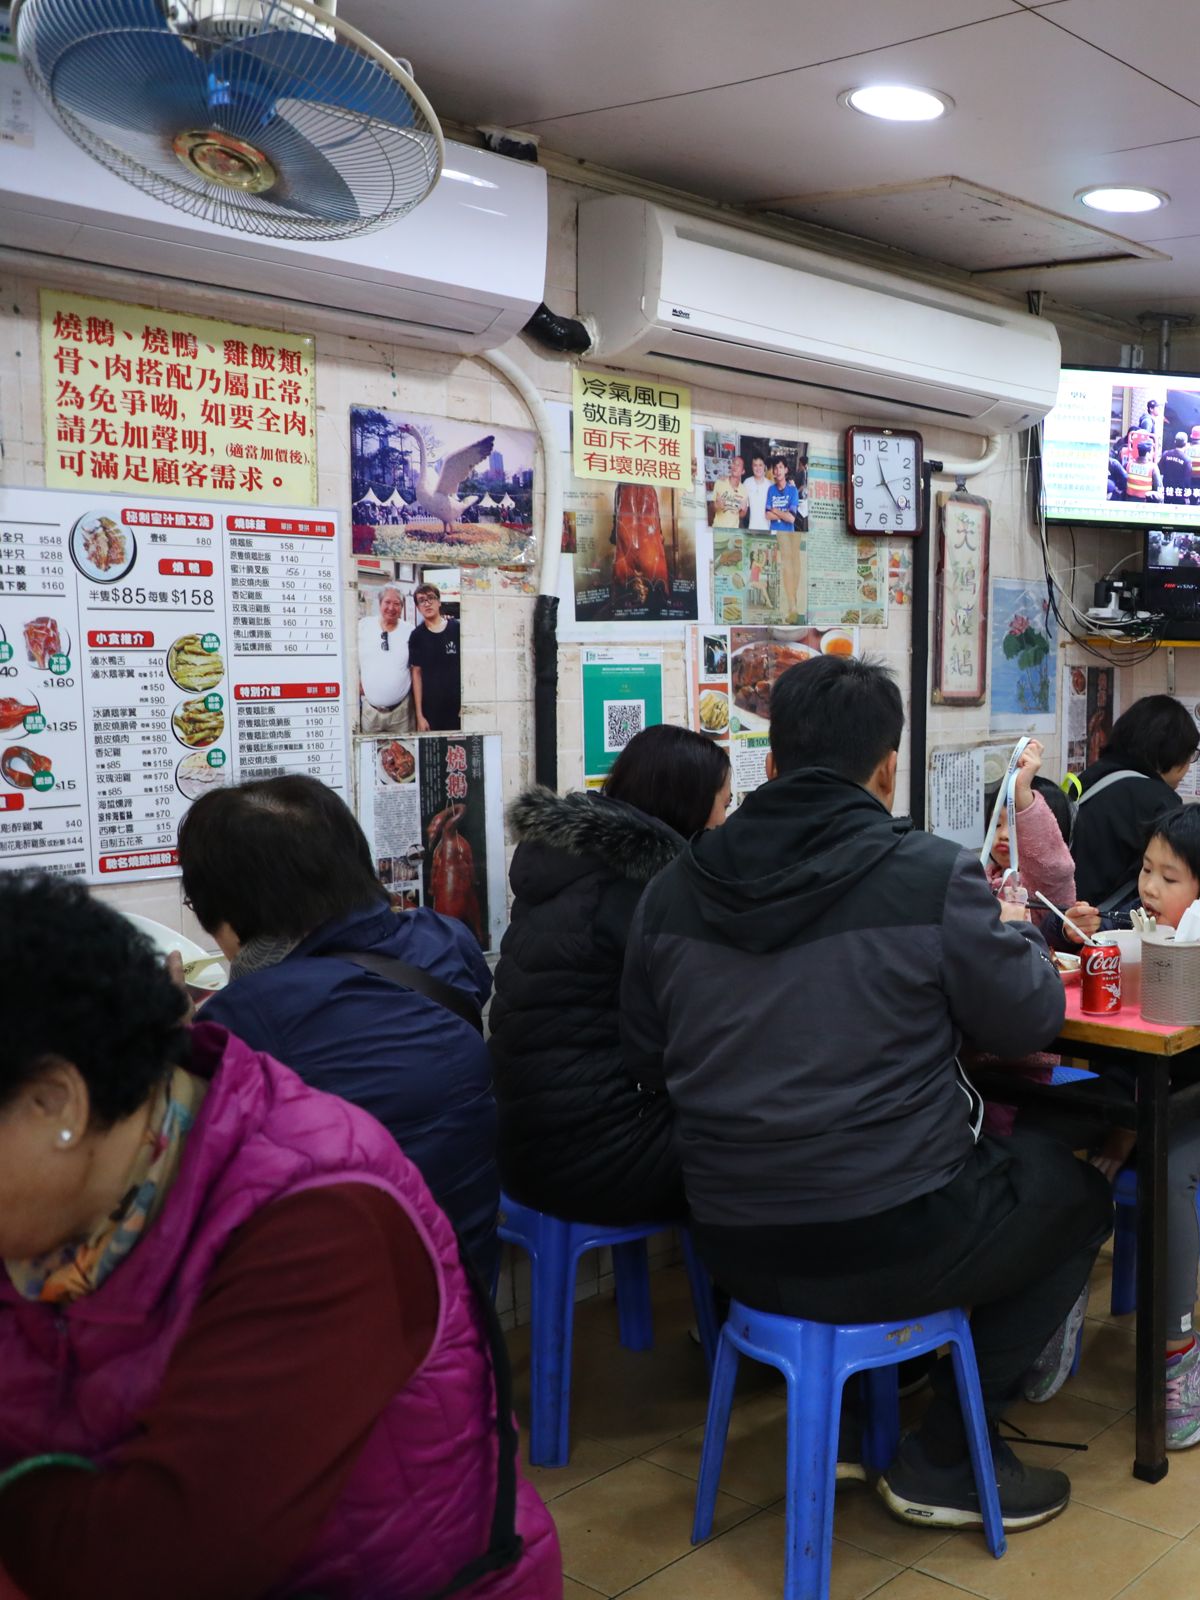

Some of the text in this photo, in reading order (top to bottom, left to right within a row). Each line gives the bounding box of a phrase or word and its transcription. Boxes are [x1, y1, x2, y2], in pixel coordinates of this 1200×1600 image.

[582, 377, 679, 409] 冷氣風口
[582, 402, 680, 433] 敬請勿動
[583, 428, 680, 458] 面斥不雅
[863, 440, 871, 451] 11
[878, 441, 888, 452] 12
[896, 442, 900, 454] 1
[854, 454, 865, 466] 10
[903, 458, 911, 469] 2
[583, 452, 681, 480] 有壞照賠
[855, 476, 863, 487] 9
[903, 478, 911, 490] 3
[855, 498, 864, 509] 8
[865, 513, 872, 524] 7
[880, 513, 888, 524] 6
[896, 514, 903, 525] 5
[0, 533, 62, 545] 全只 $548
[197, 538, 211, 546] $80
[0, 549, 63, 560] 半只 $288
[281, 555, 299, 563] $140
[41, 566, 64, 575] $140
[42, 582, 64, 591] $160
[111, 587, 146, 604] $85
[172, 589, 213, 605] $158
[149, 670, 164, 678] $14
[43, 678, 74, 688] $160
[150, 696, 165, 704] $90
[151, 709, 165, 717] $50
[47, 721, 77, 732] $135
[151, 722, 166, 730] $90
[153, 747, 167, 755] $70
[107, 759, 173, 769] $85 $158
[154, 772, 168, 780] $70
[446, 745, 467, 798] 燒鵝
[55, 780, 76, 790] $15
[108, 785, 174, 796] $85 $158
[155, 797, 170, 805] $70
[156, 810, 170, 818] $70
[66, 819, 82, 828] $40
[157, 823, 171, 831] $15
[67, 836, 83, 845] $44
[157, 835, 172, 843] $20
